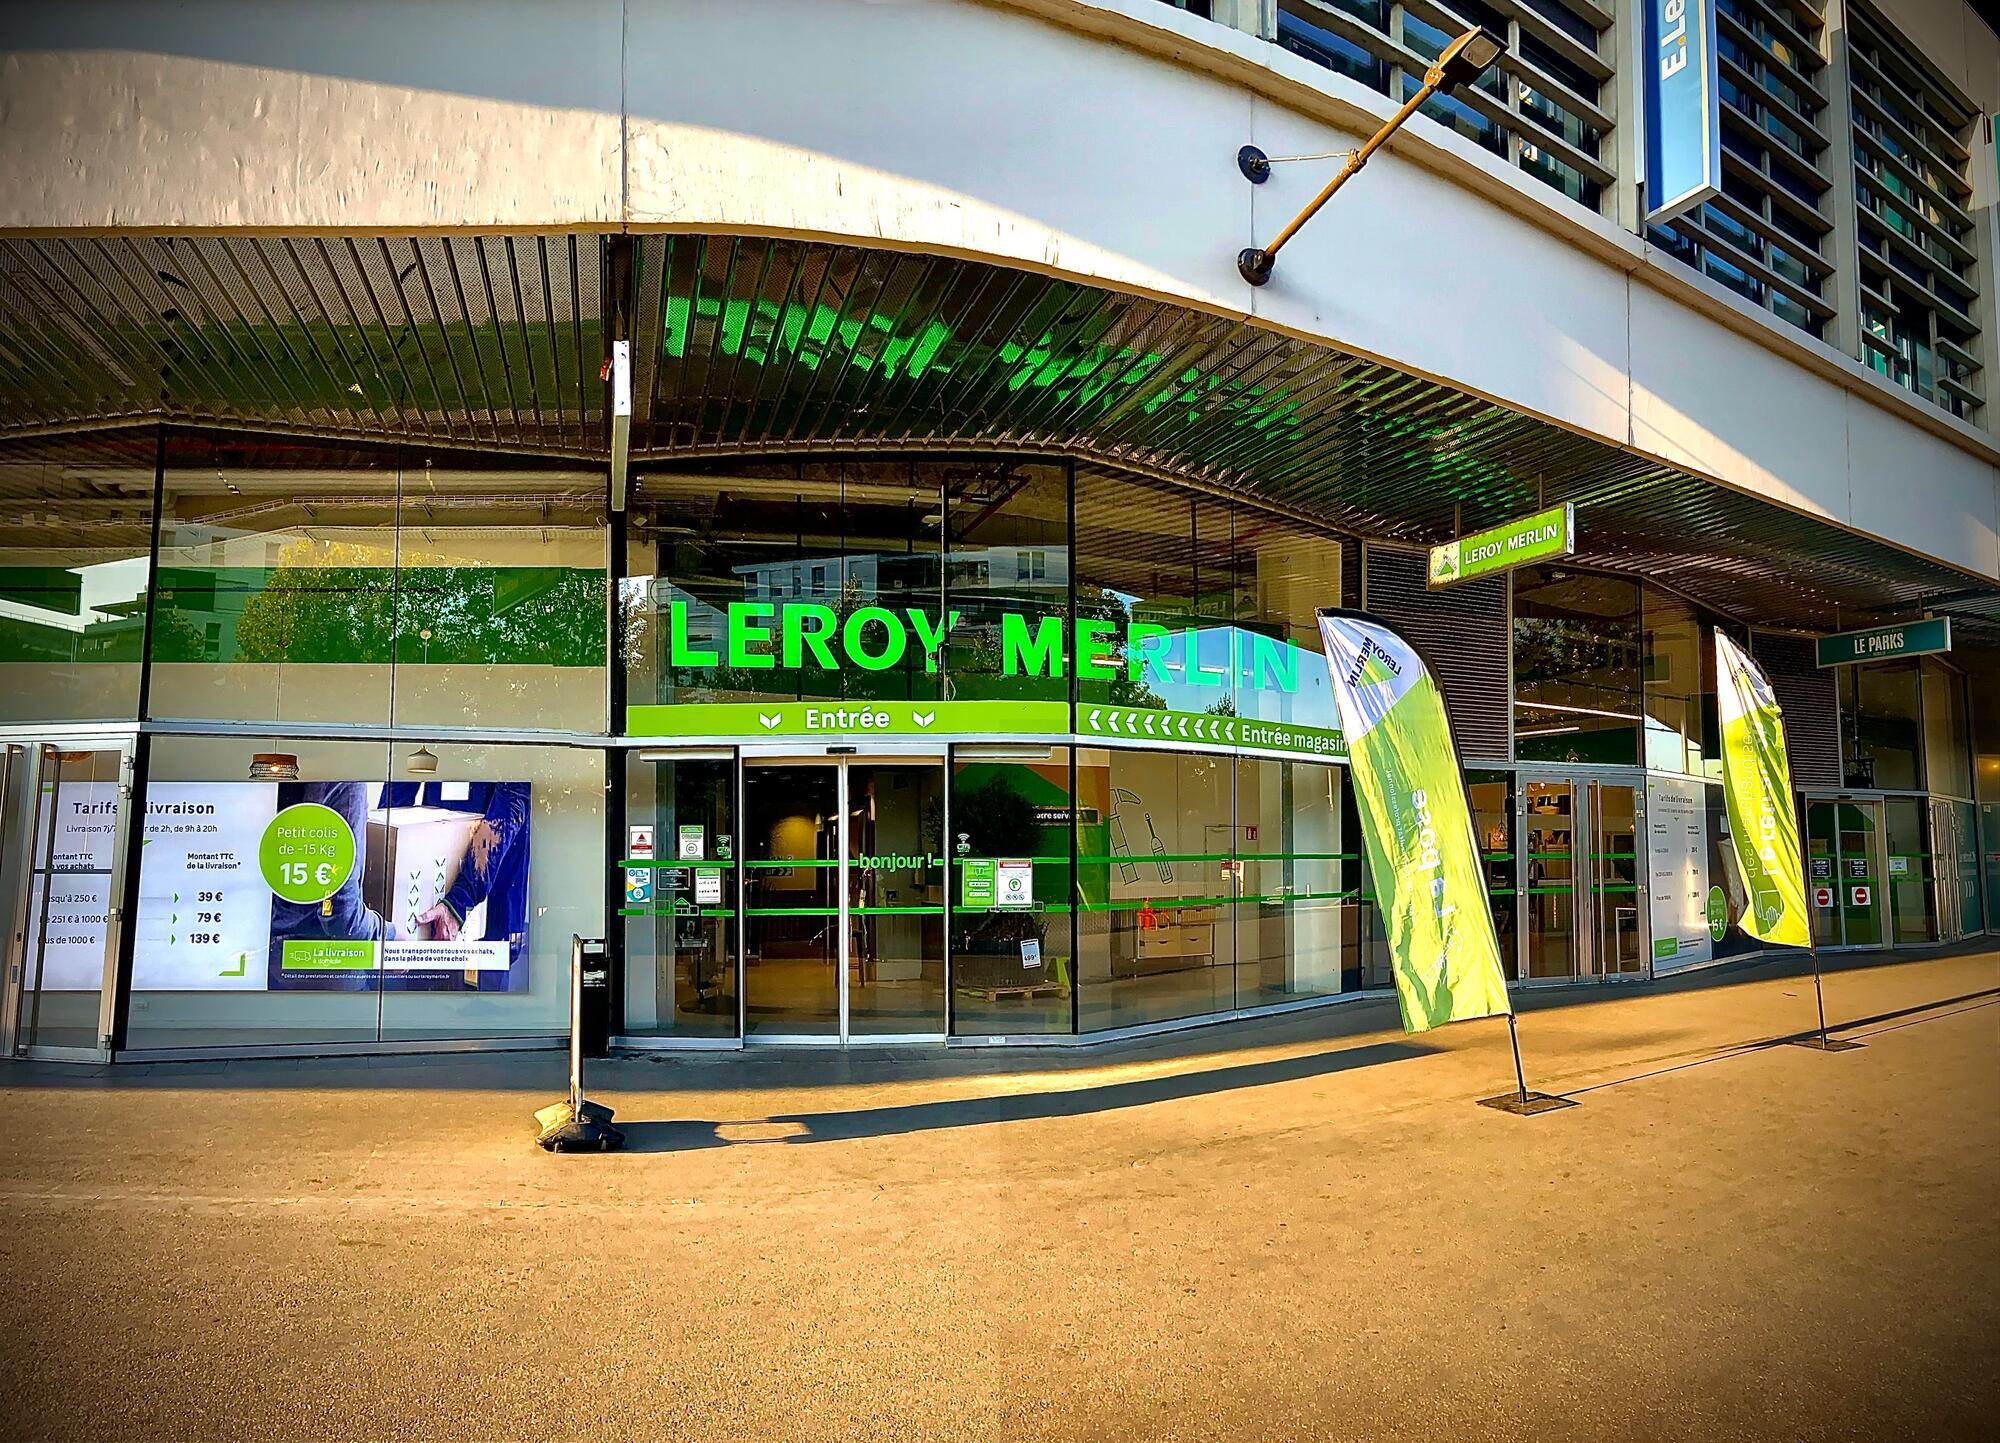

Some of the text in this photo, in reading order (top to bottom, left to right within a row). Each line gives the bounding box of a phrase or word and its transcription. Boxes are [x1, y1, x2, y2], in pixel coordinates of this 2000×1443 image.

[1464, 540, 1503, 565] LEROY
[1507, 523, 1558, 551] MERLIN
[671, 600, 1299, 693] LEROY MERLIN
[1854, 639, 1866, 654] LE
[1869, 632, 1905, 652] PARKS
[806, 705, 890, 729] Entrée
[1242, 725, 1291, 746] Entrée
[73, 801, 215, 814] Tarifs livraison
[161, 825, 172, 833] 2h,
[196, 824, 202, 832] à
[277, 827, 338, 838] Petit colis
[278, 843, 336, 858] de -15 Kg
[70, 862, 94, 870] achats
[280, 863, 308, 885] 15
[49, 894, 72, 904] squ'à
[198, 892, 223, 902] 39 €
[197, 913, 222, 923] 79 €
[56, 936, 66, 944] de
[68, 936, 88, 944] 1000
[90, 936, 96, 944] €
[190, 933, 220, 944] 139 €
[313, 946, 365, 957] La livraison
